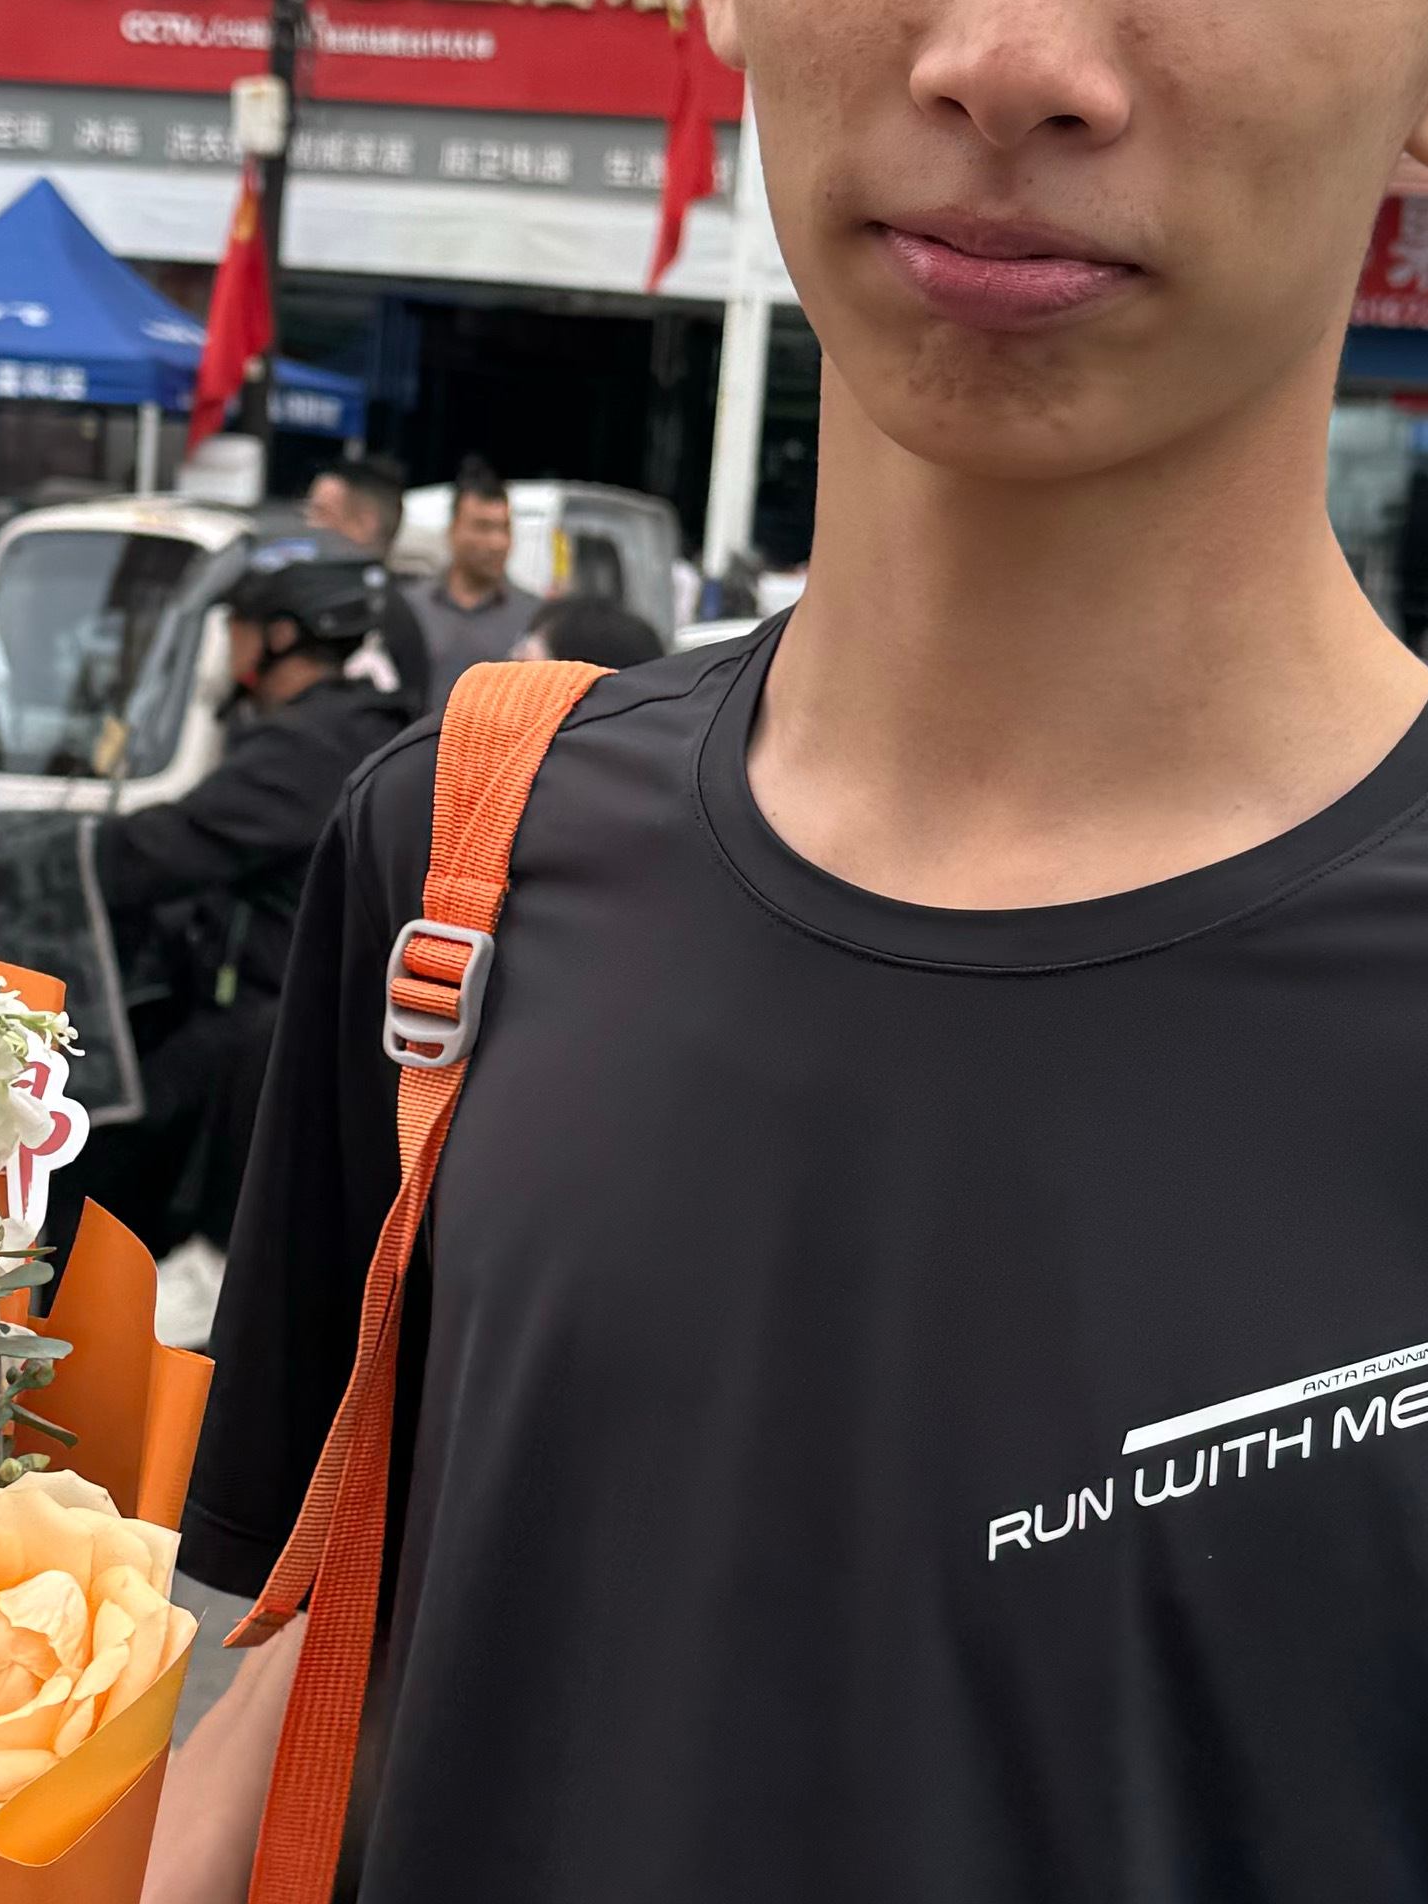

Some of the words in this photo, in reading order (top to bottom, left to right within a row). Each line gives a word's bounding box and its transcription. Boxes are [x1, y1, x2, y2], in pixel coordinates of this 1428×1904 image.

[1303, 1369, 1358, 1395] ANTA
[987, 1477, 1114, 1561] RUN
[1134, 1417, 1313, 1507] WITH
